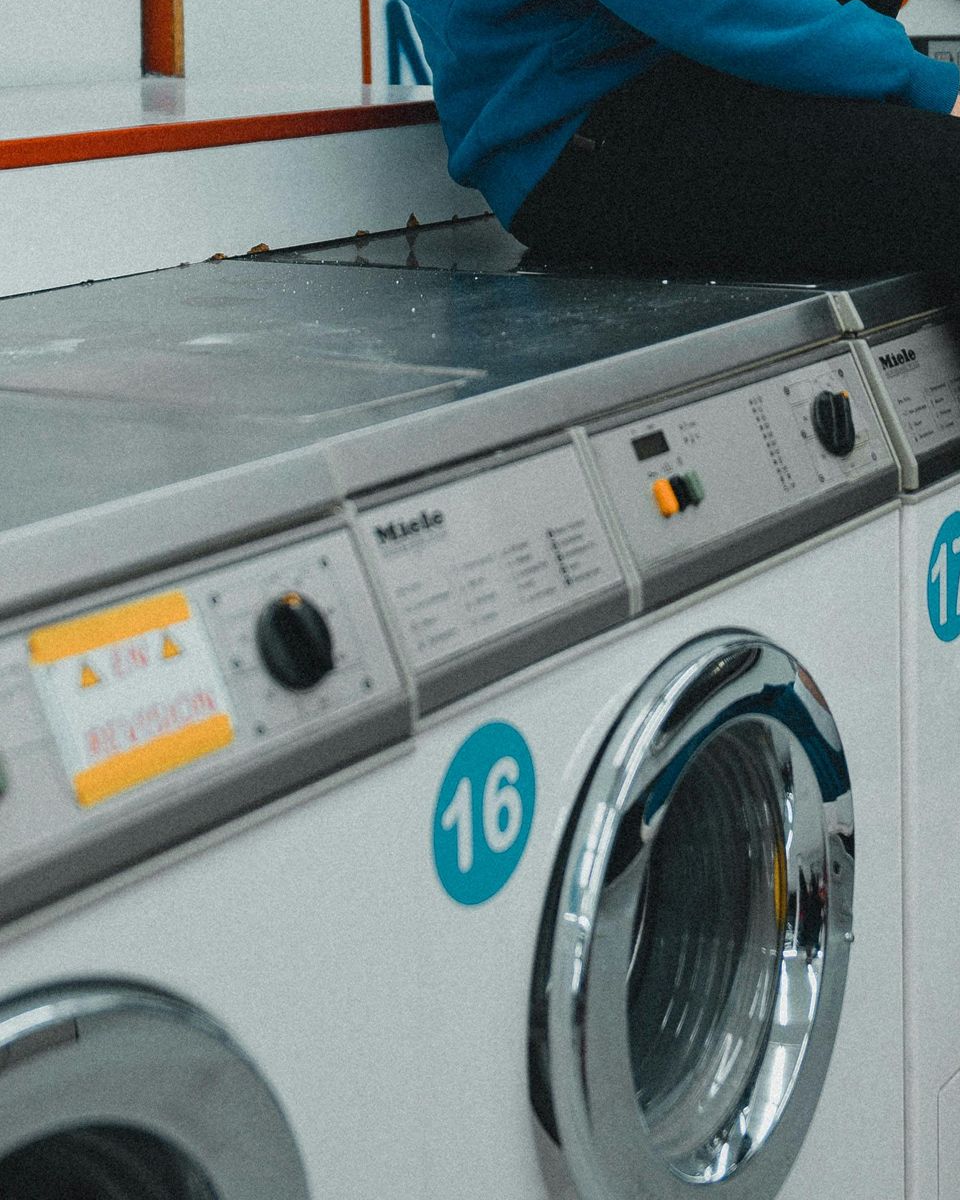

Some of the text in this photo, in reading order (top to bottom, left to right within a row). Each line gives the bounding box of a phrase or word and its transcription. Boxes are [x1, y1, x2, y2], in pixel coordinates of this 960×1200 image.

[878, 348, 917, 371] Miele
[373, 509, 444, 544] Miele
[440, 755, 523, 874] 16
